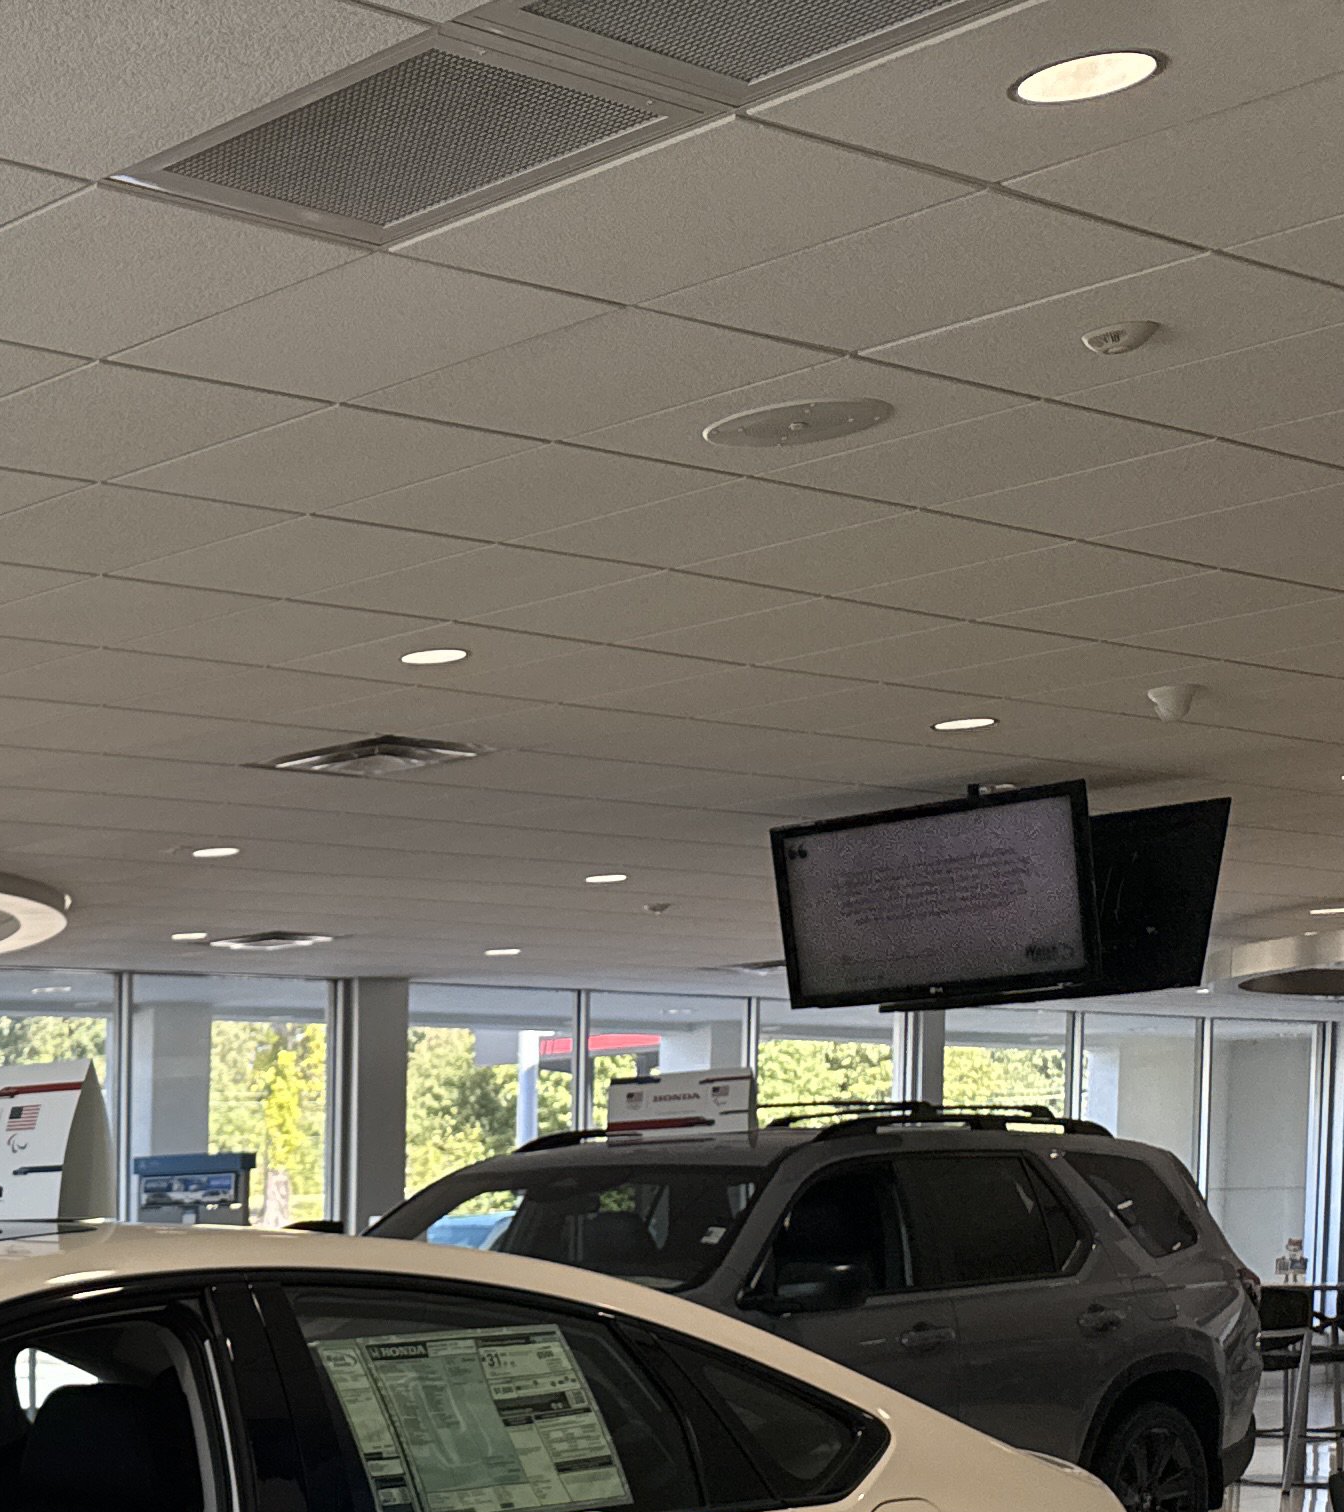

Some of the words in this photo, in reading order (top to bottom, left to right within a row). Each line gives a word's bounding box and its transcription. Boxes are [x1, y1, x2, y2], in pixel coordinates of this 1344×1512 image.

[653, 1092, 701, 1103] HONDA
[381, 1345, 427, 1358] HONDA
[486, 1353, 502, 1367] 31
